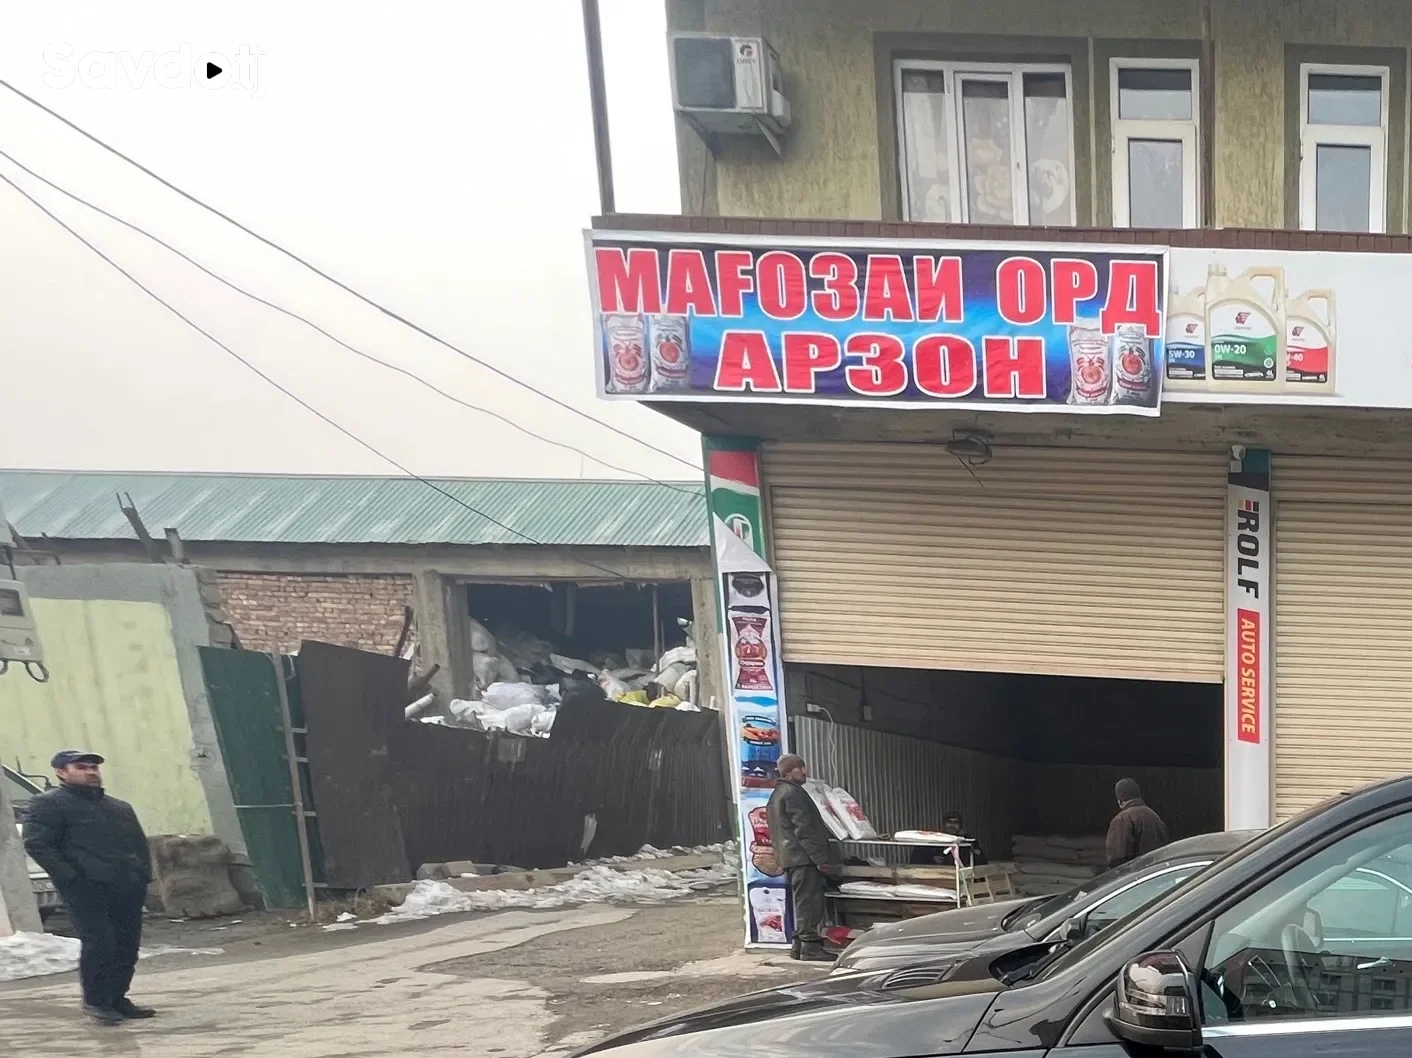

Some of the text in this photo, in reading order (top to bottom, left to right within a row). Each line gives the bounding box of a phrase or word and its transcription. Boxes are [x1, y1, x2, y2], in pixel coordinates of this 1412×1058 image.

[996, 256, 1162, 338] ОРД
[713, 329, 1047, 398] АРЗОН
[1214, 344, 1247, 354] 0W-20
[1237, 509, 1260, 599] ROLF
[1241, 617, 1256, 734] AUTO SERVICE
